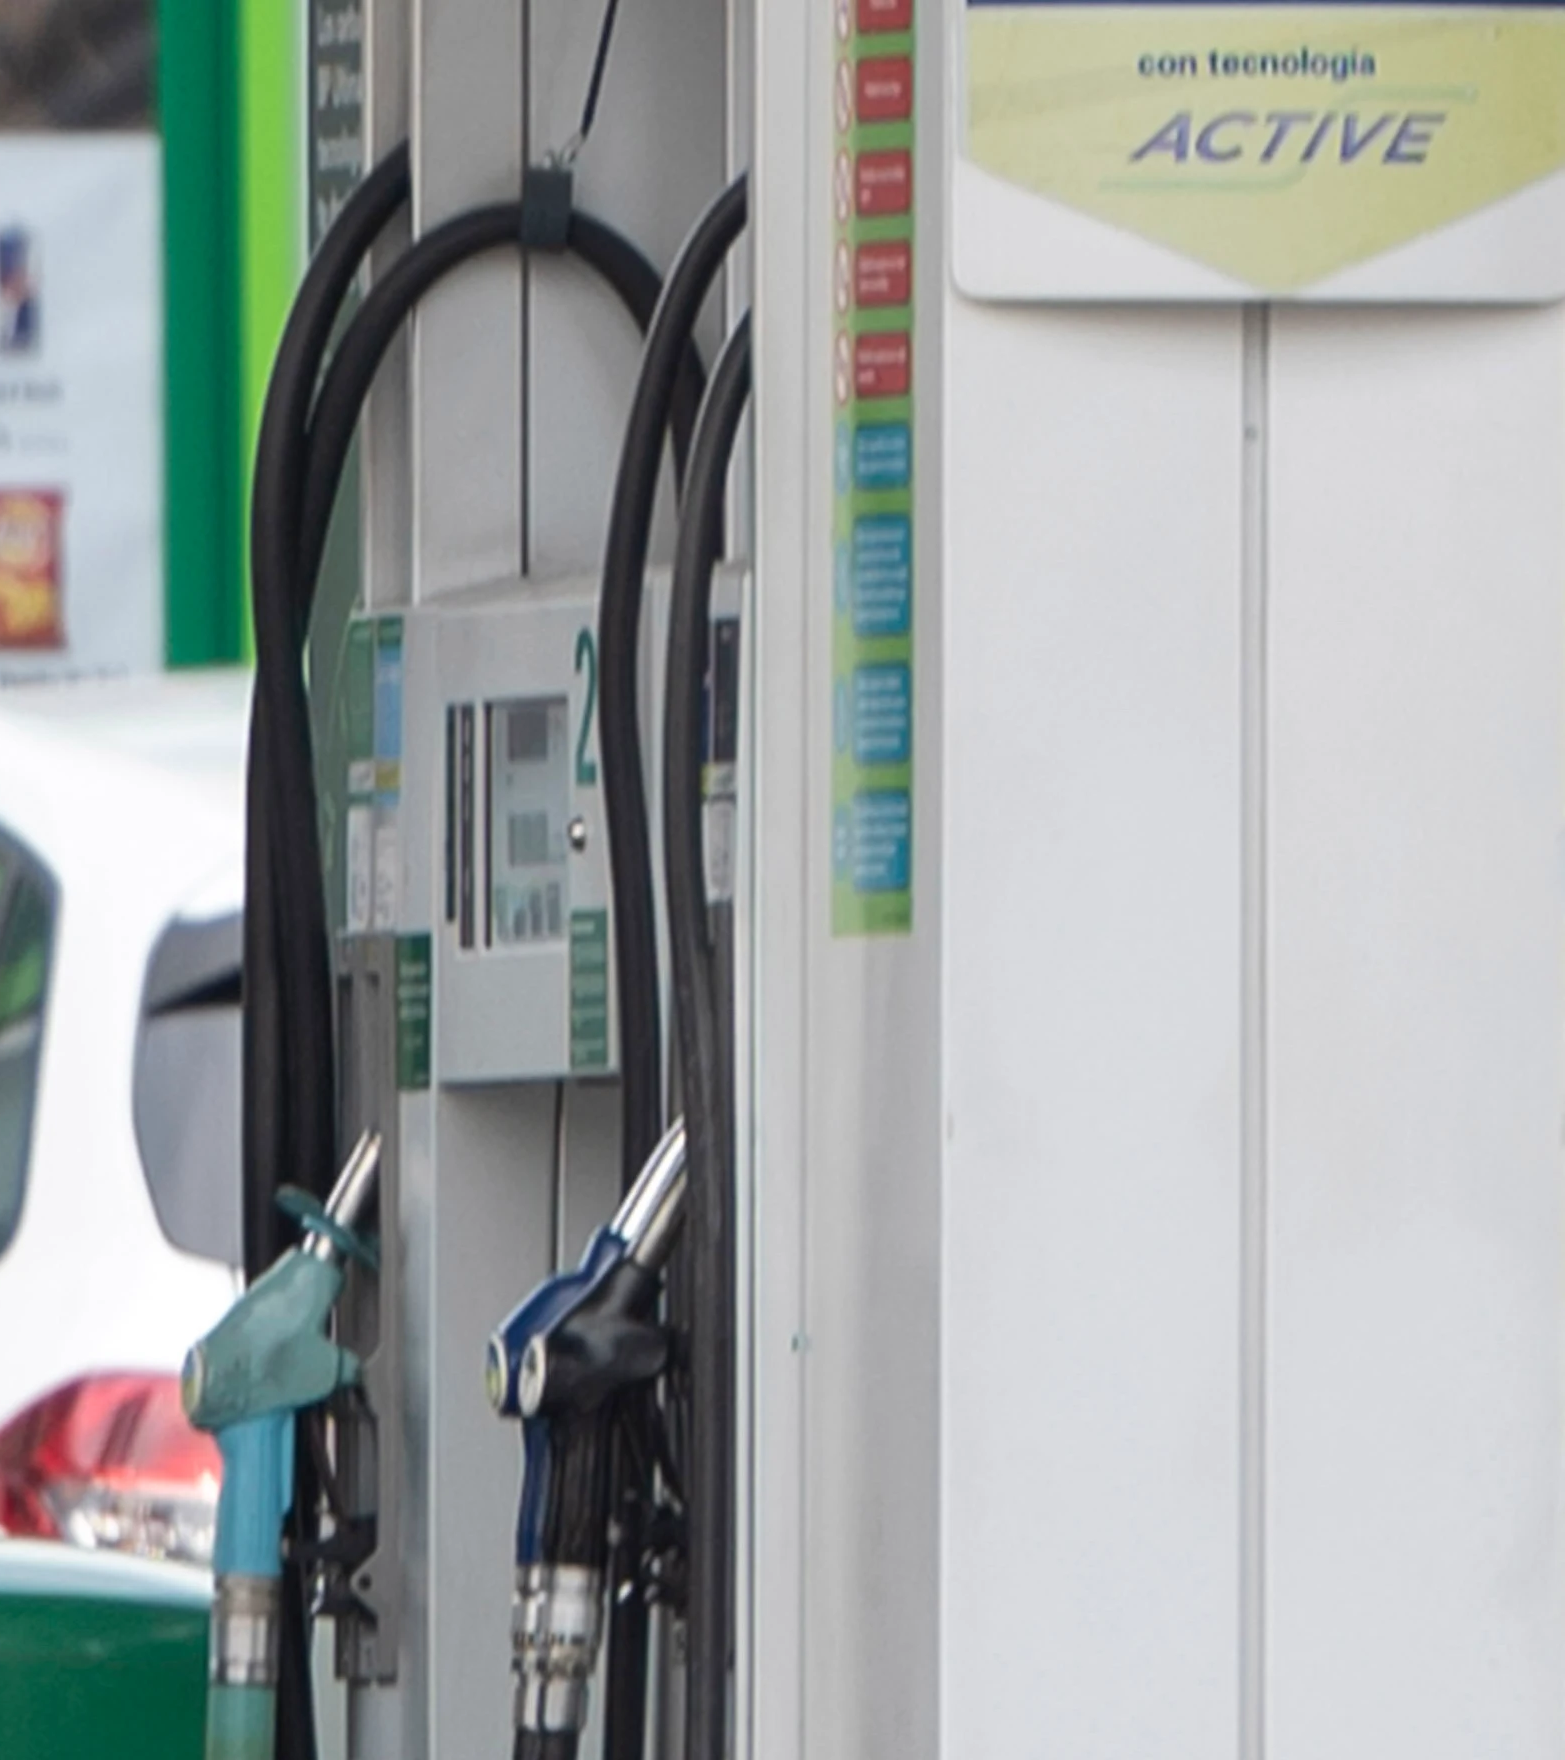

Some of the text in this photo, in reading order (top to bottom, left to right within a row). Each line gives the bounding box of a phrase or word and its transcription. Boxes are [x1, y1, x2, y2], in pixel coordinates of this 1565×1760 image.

[1137, 53, 1199, 78] con
[1129, 108, 1447, 165] ACTIVE
[574, 626, 598, 787] 2
